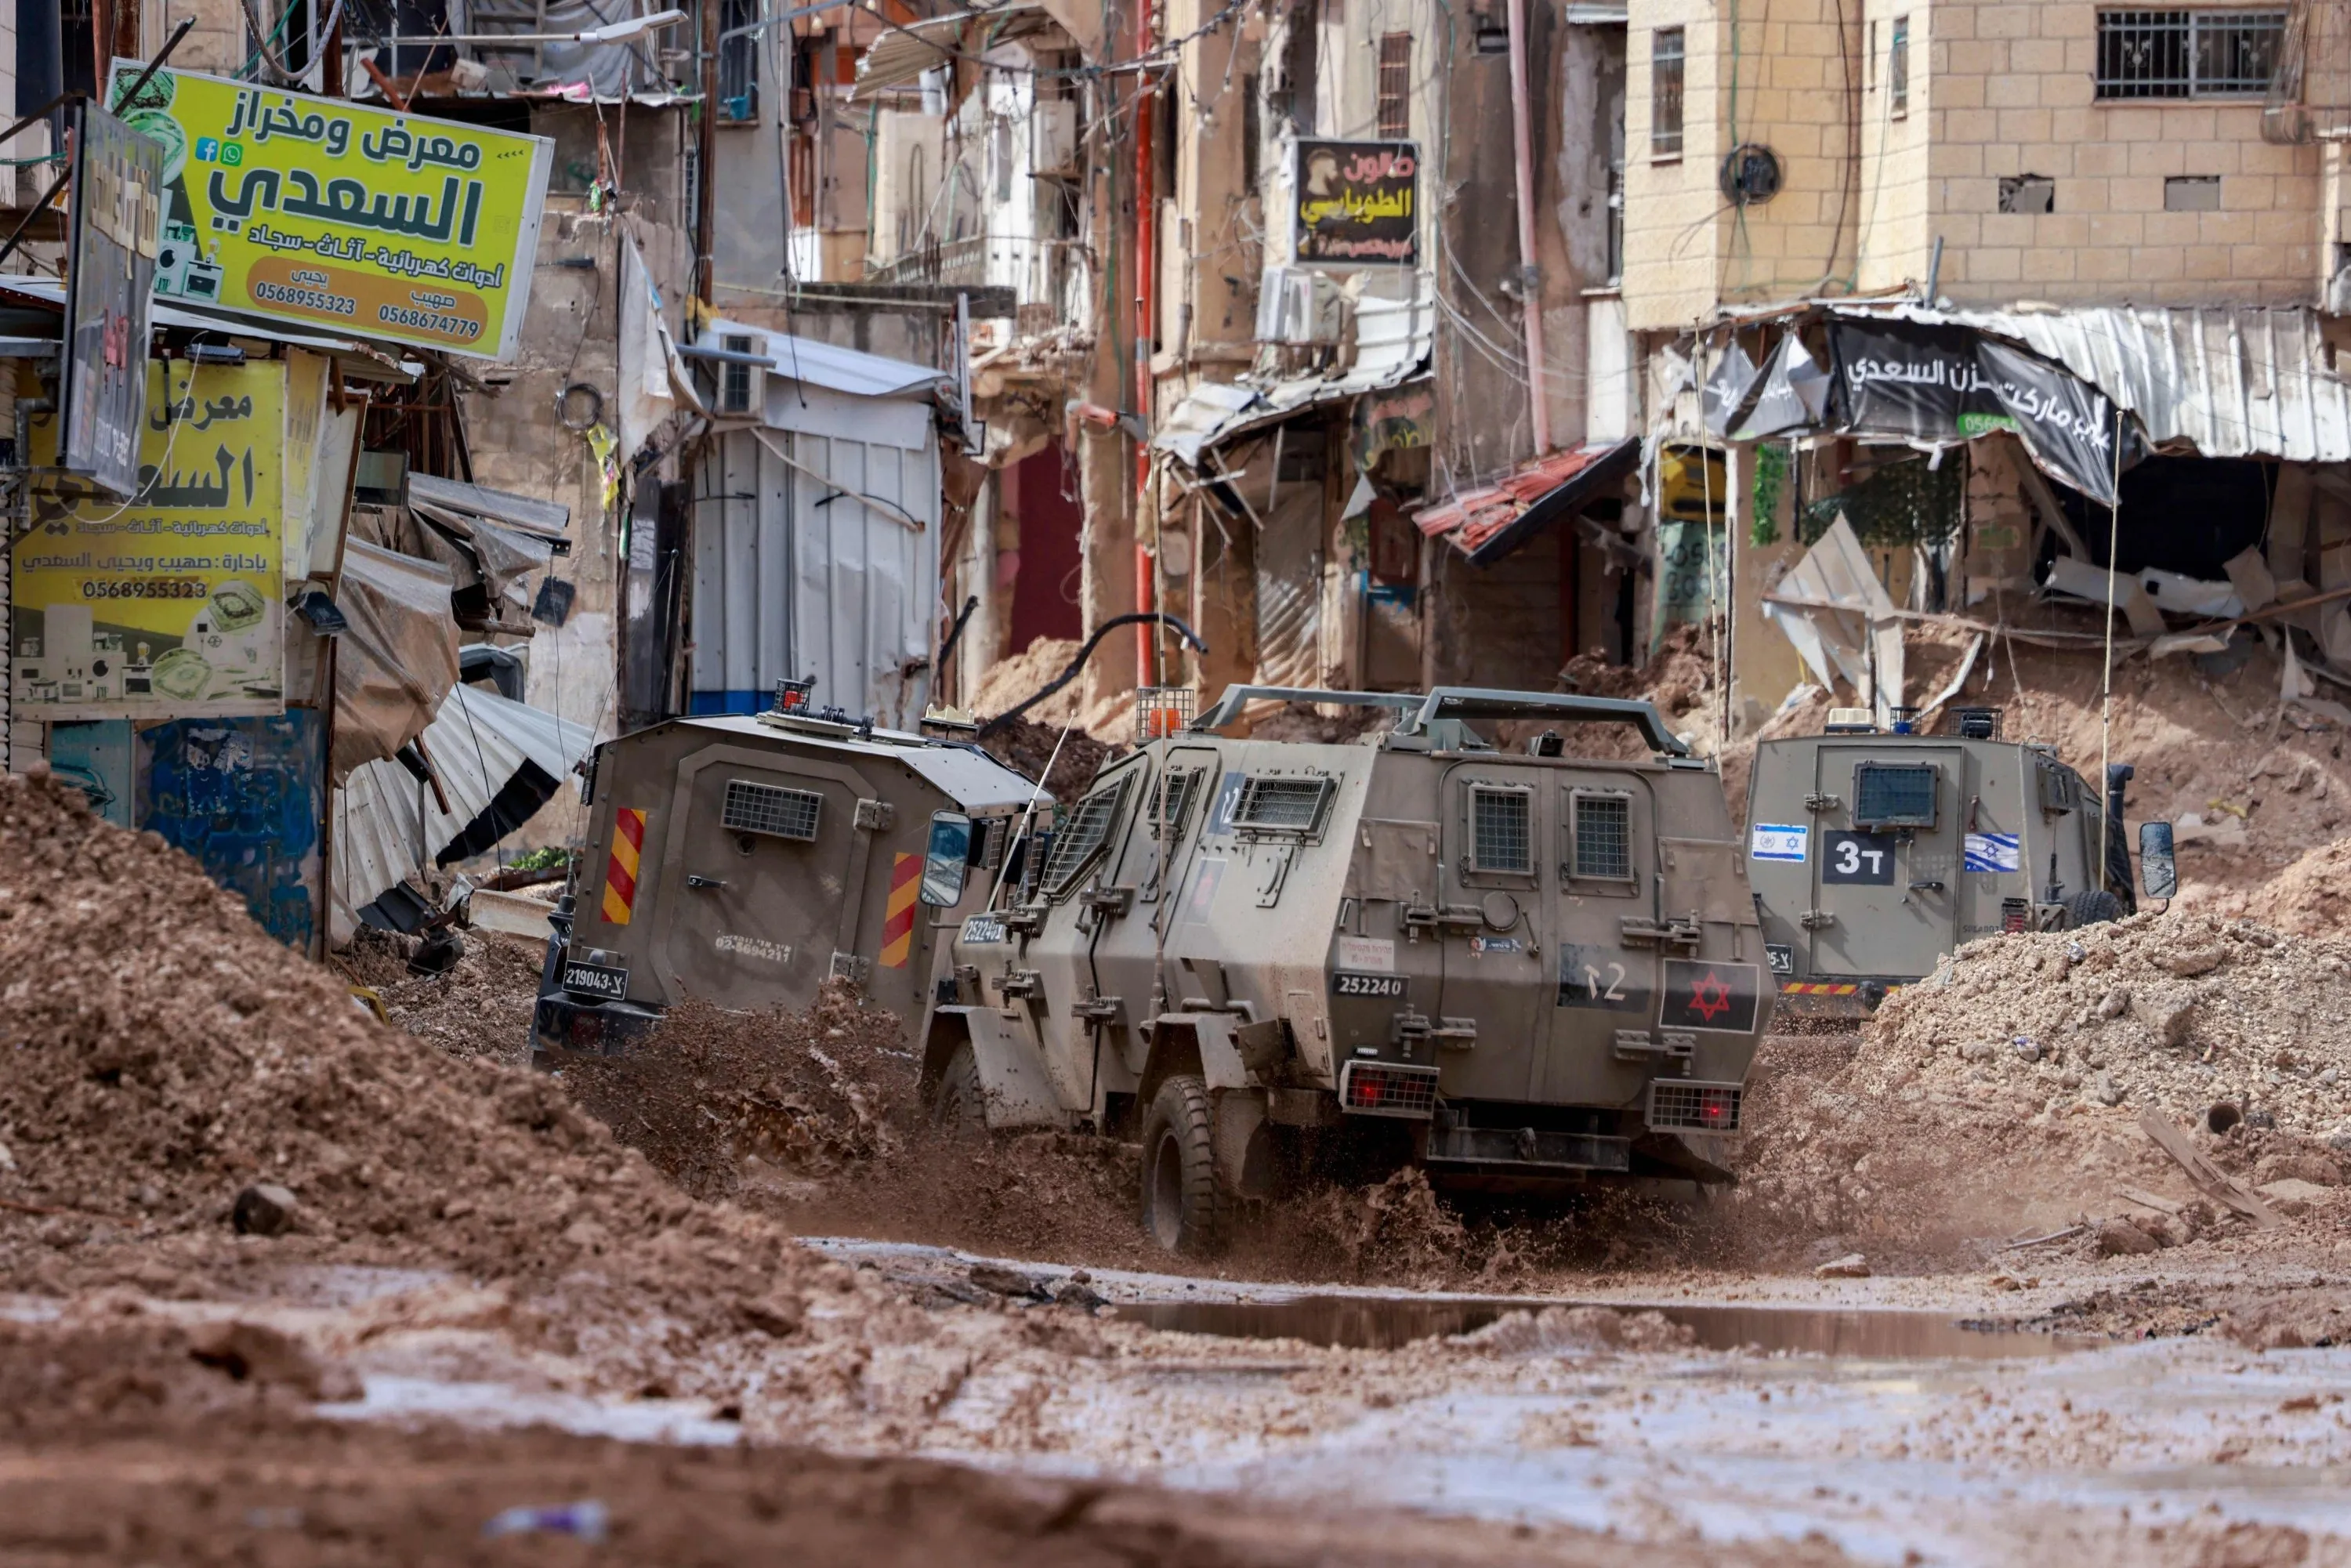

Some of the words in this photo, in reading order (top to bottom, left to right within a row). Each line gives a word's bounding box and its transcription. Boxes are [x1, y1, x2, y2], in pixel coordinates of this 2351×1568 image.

[226, 91, 350, 155] ومخراز
[362, 120, 480, 171] معرض
[208, 168, 482, 245] السعدي
[248, 226, 301, 251] سجاد
[378, 248, 450, 277] كهربائية
[452, 264, 504, 288] أدوات
[256, 282, 356, 315] 0568955323
[411, 289, 456, 310] صهيب
[379, 306, 480, 337] 0568674779
[1848, 357, 1944, 391] السعدي
[150, 381, 253, 431] معرض
[1998, 381, 2070, 427] ماركت
[173, 520, 226, 536] كهربائية
[229, 518, 266, 537] أدوات
[22, 552, 91, 572] السعدي
[159, 554, 211, 572] صهيب
[83, 581, 208, 598] 0568955323
[1339, 976, 1401, 994] 252240
